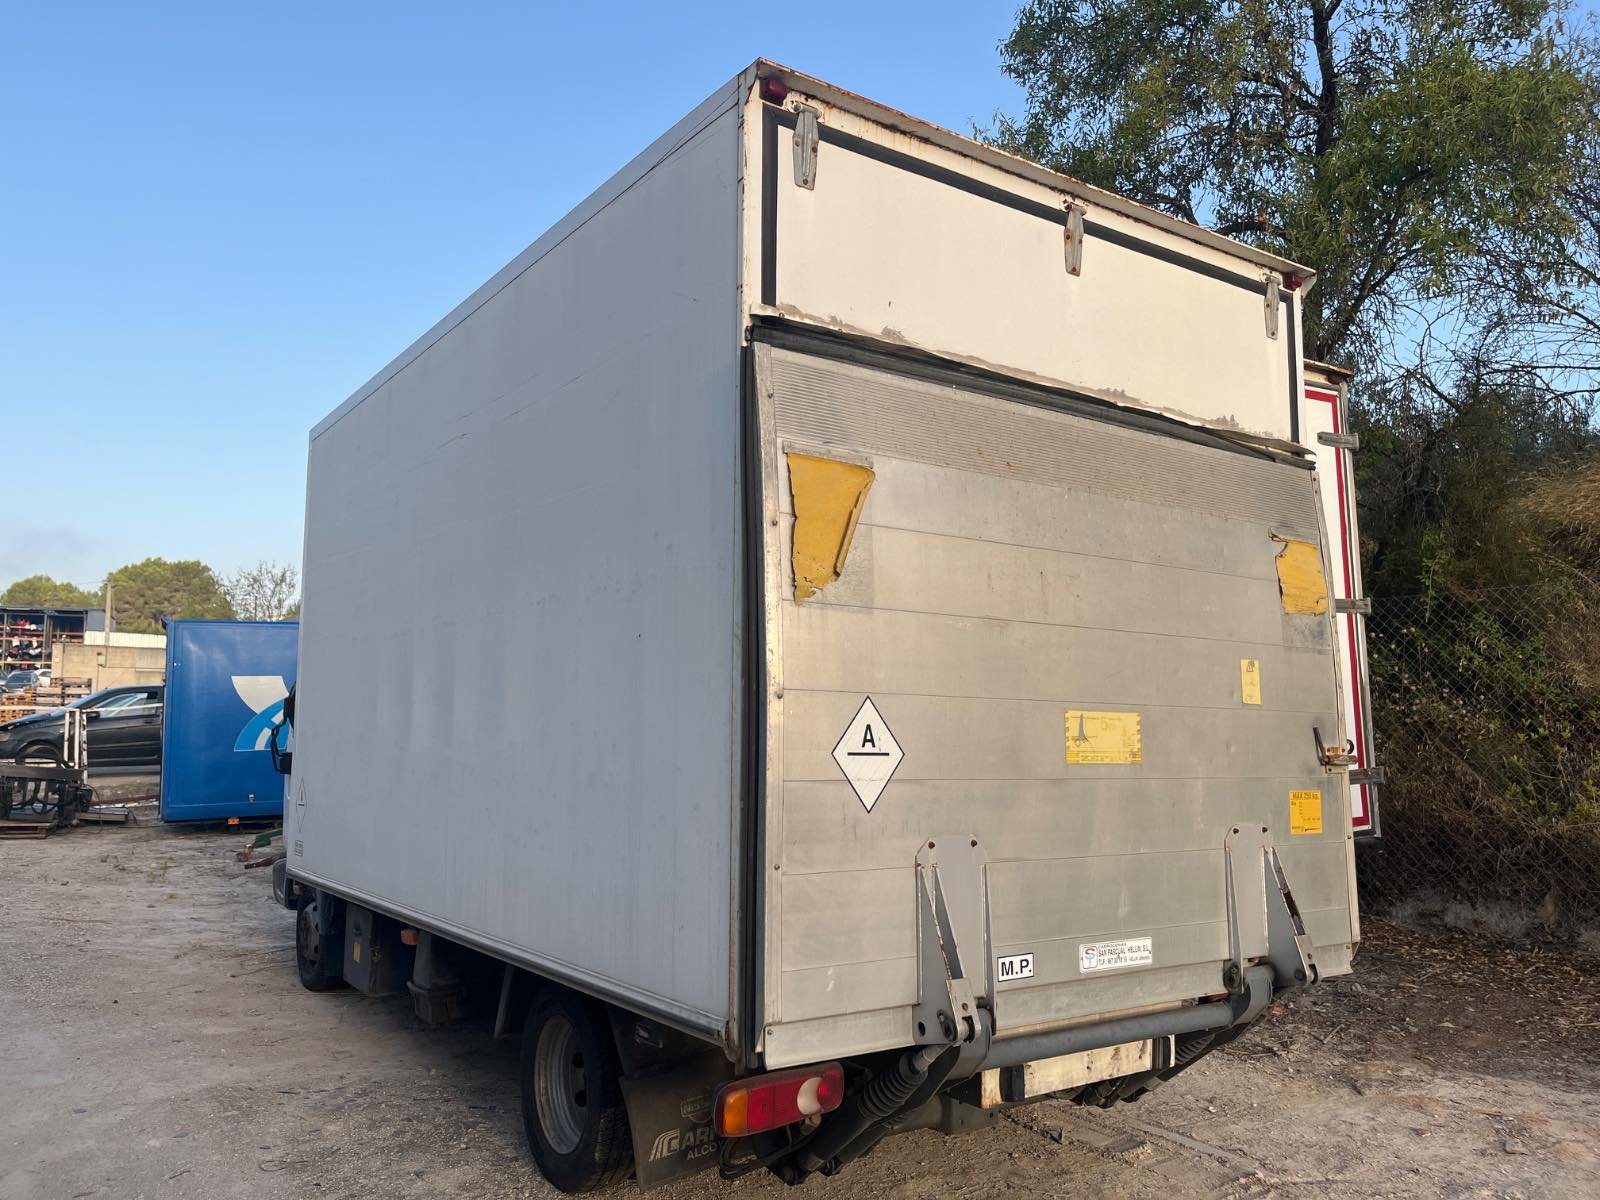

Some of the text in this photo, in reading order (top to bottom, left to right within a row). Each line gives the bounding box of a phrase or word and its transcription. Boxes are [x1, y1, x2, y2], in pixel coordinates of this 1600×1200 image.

[861, 724, 876, 748] A
[1098, 949, 1107, 957] SAN
[1001, 958, 1032, 977] M.P.
[686, 1142, 718, 1161] ALCO
